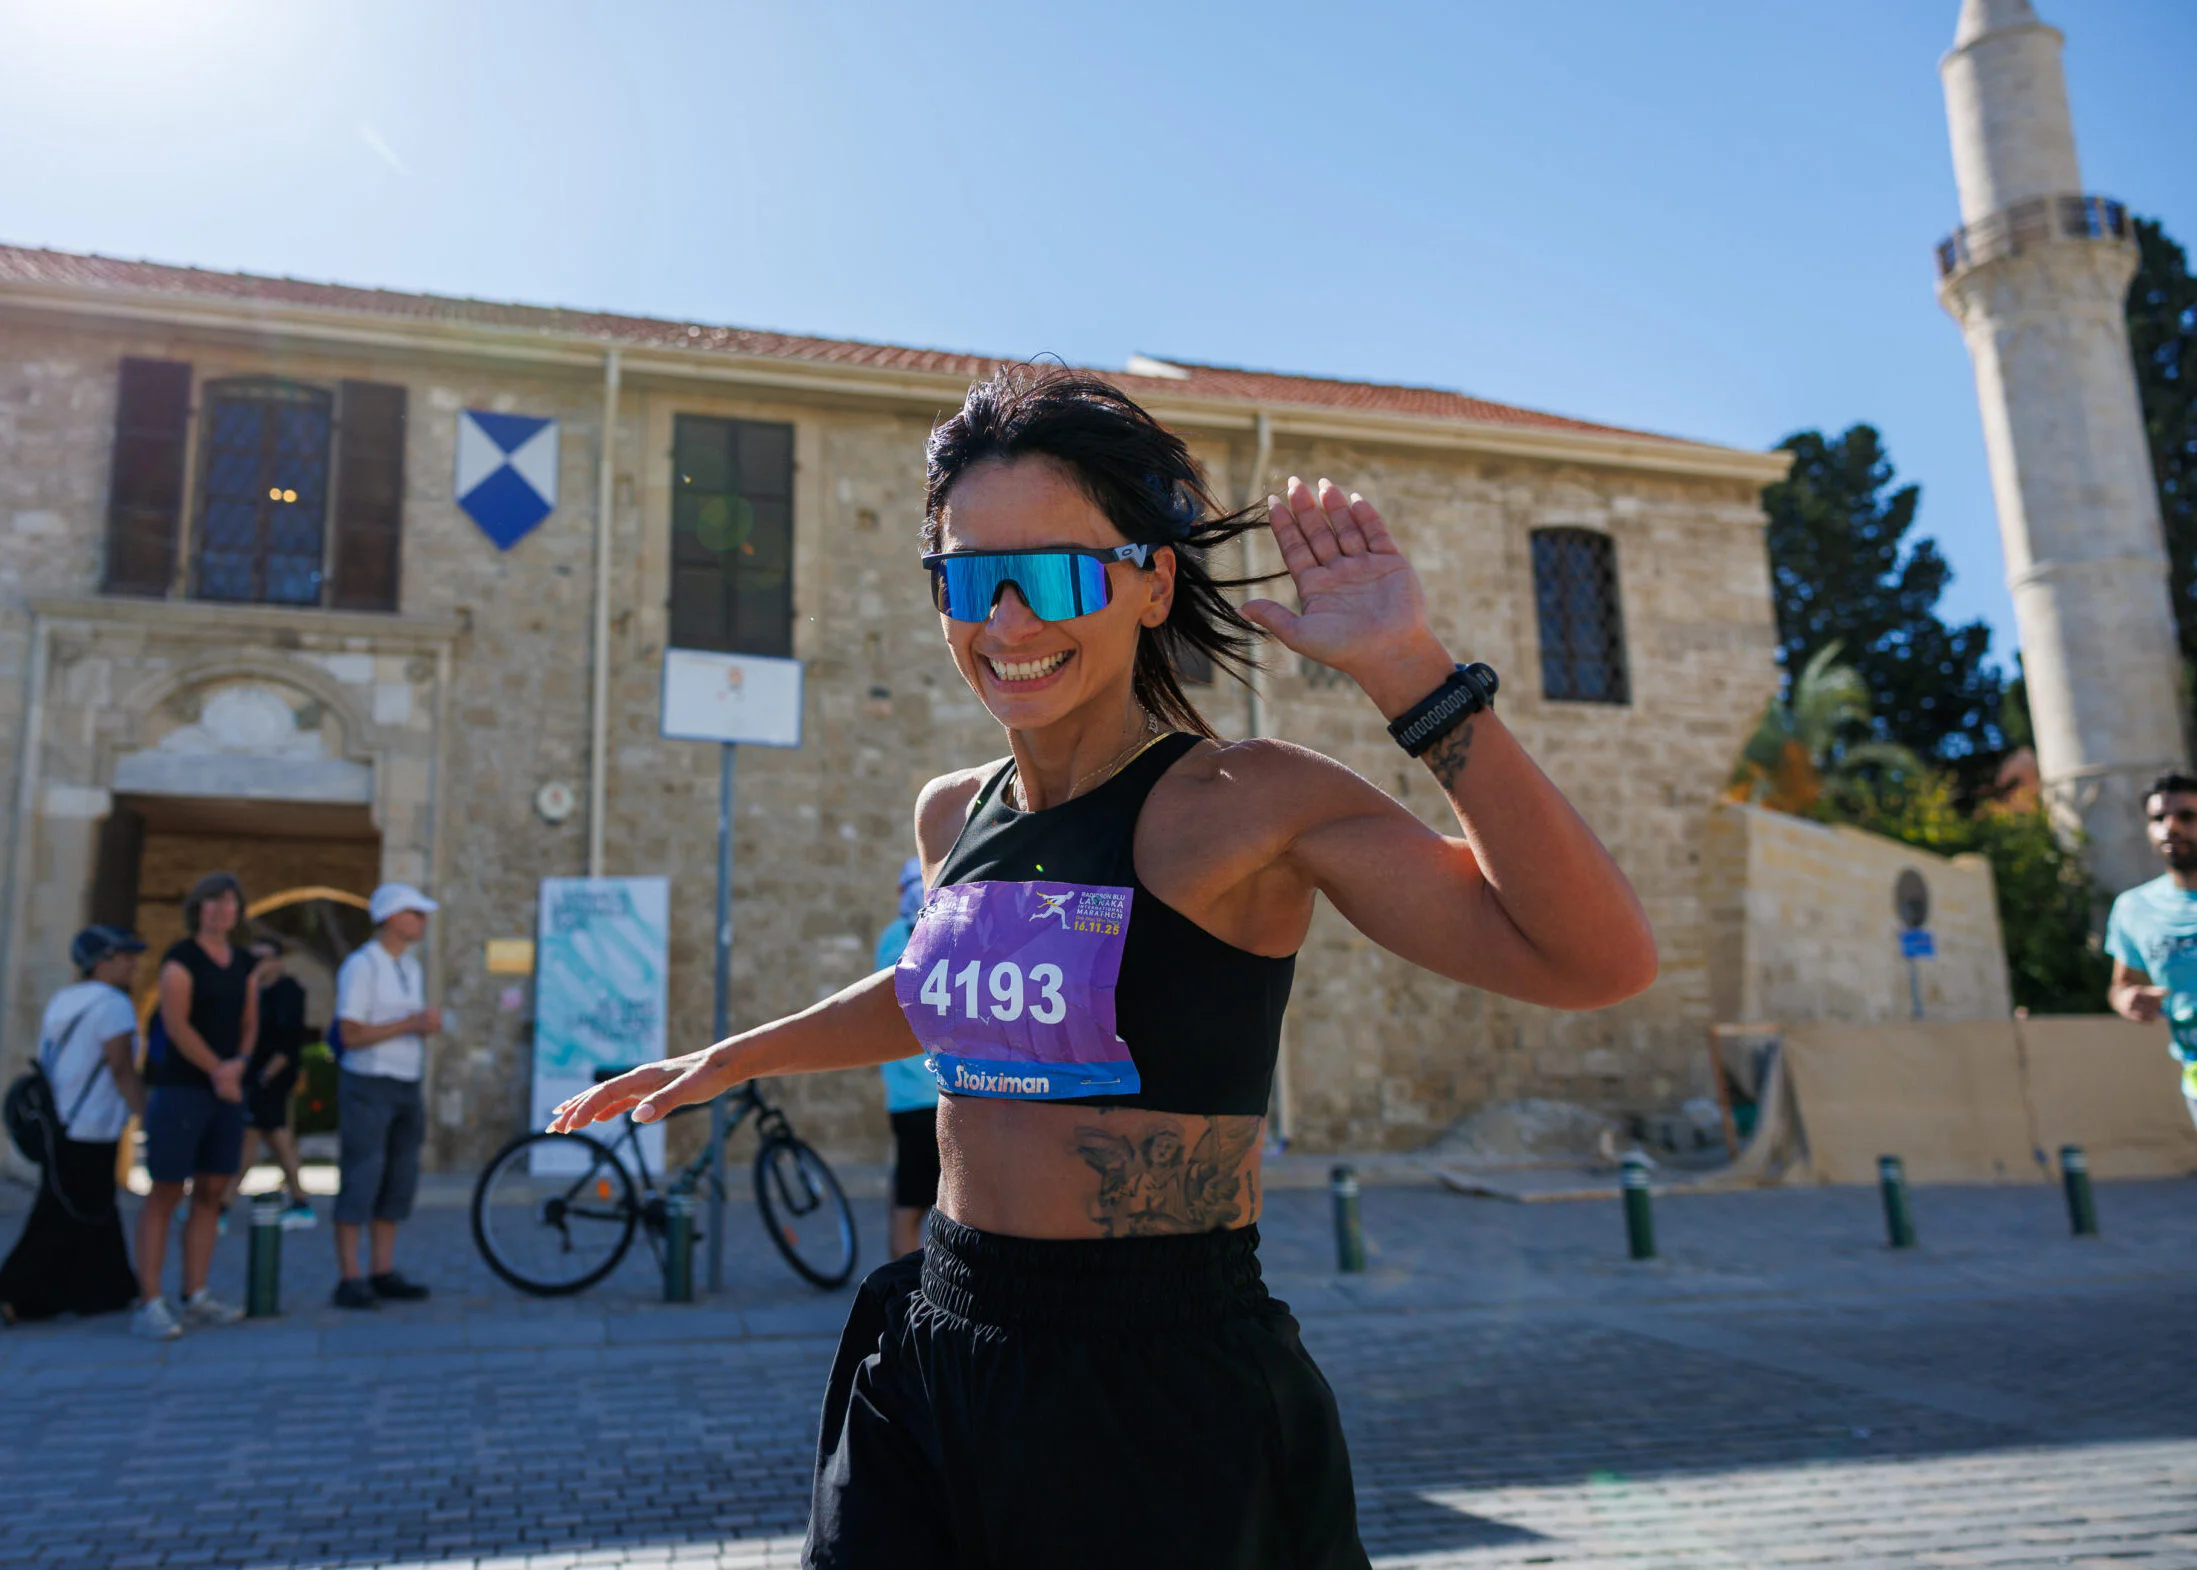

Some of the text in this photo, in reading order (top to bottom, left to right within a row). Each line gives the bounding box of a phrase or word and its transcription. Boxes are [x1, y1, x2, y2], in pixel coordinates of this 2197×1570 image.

[1076, 908, 1123, 919] MARATHON
[1074, 921, 1120, 935] 16.11.25
[920, 959, 1067, 1024] 4193
[954, 1064, 1050, 1094] Stoiximan
